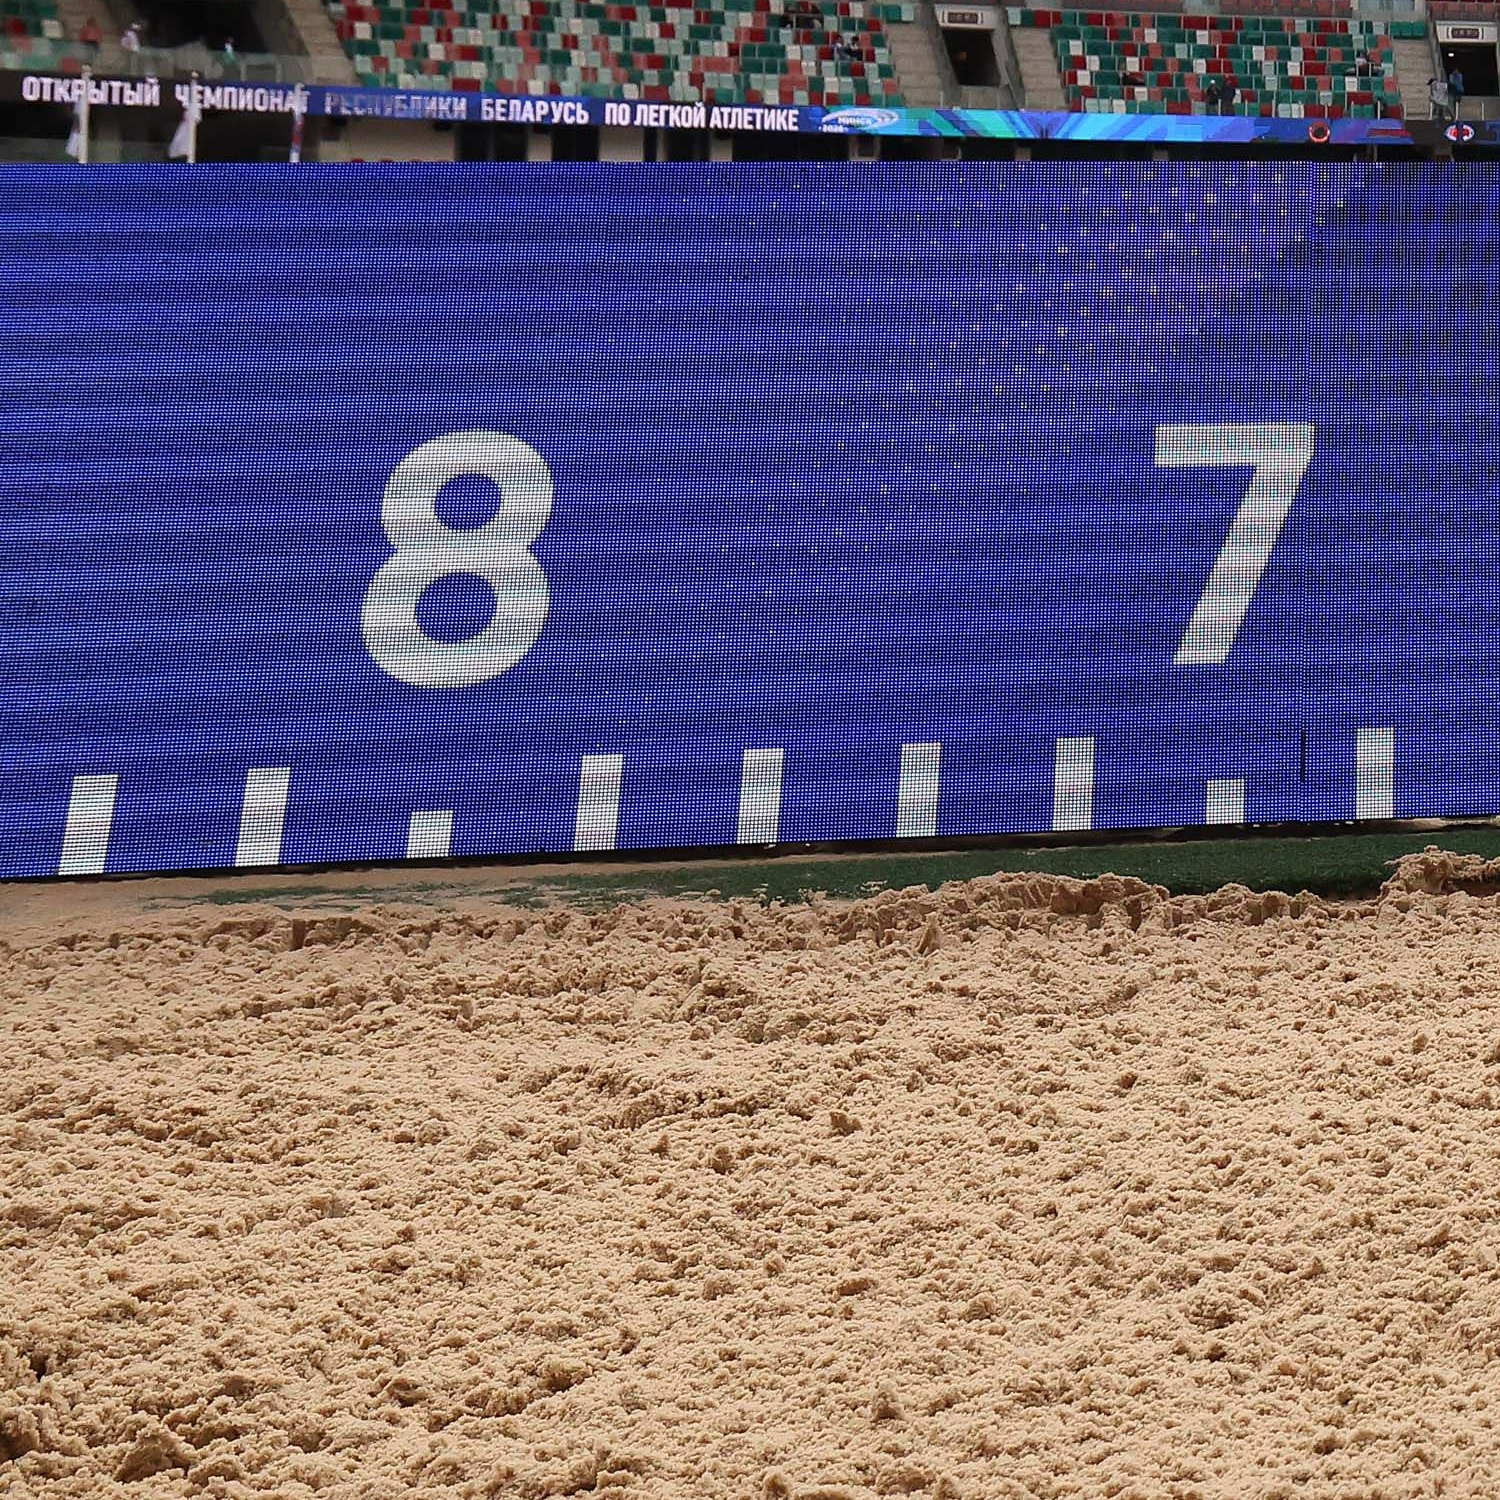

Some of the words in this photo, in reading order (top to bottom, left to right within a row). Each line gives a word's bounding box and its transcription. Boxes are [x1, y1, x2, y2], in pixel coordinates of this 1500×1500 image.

[22, 76, 160, 106] ОТКРЫТЫЙ
[175, 84, 311, 112] ЧЕМПИОНАТ
[481, 98, 589, 125] БЕЛАРУСЬ
[605, 103, 632, 126] ПО
[634, 102, 702, 128] ЛЕГКОЙ
[710, 106, 799, 131] АТЛЕТИКЕ
[361, 430, 553, 687] 8
[1154, 423, 1315, 665] 7
